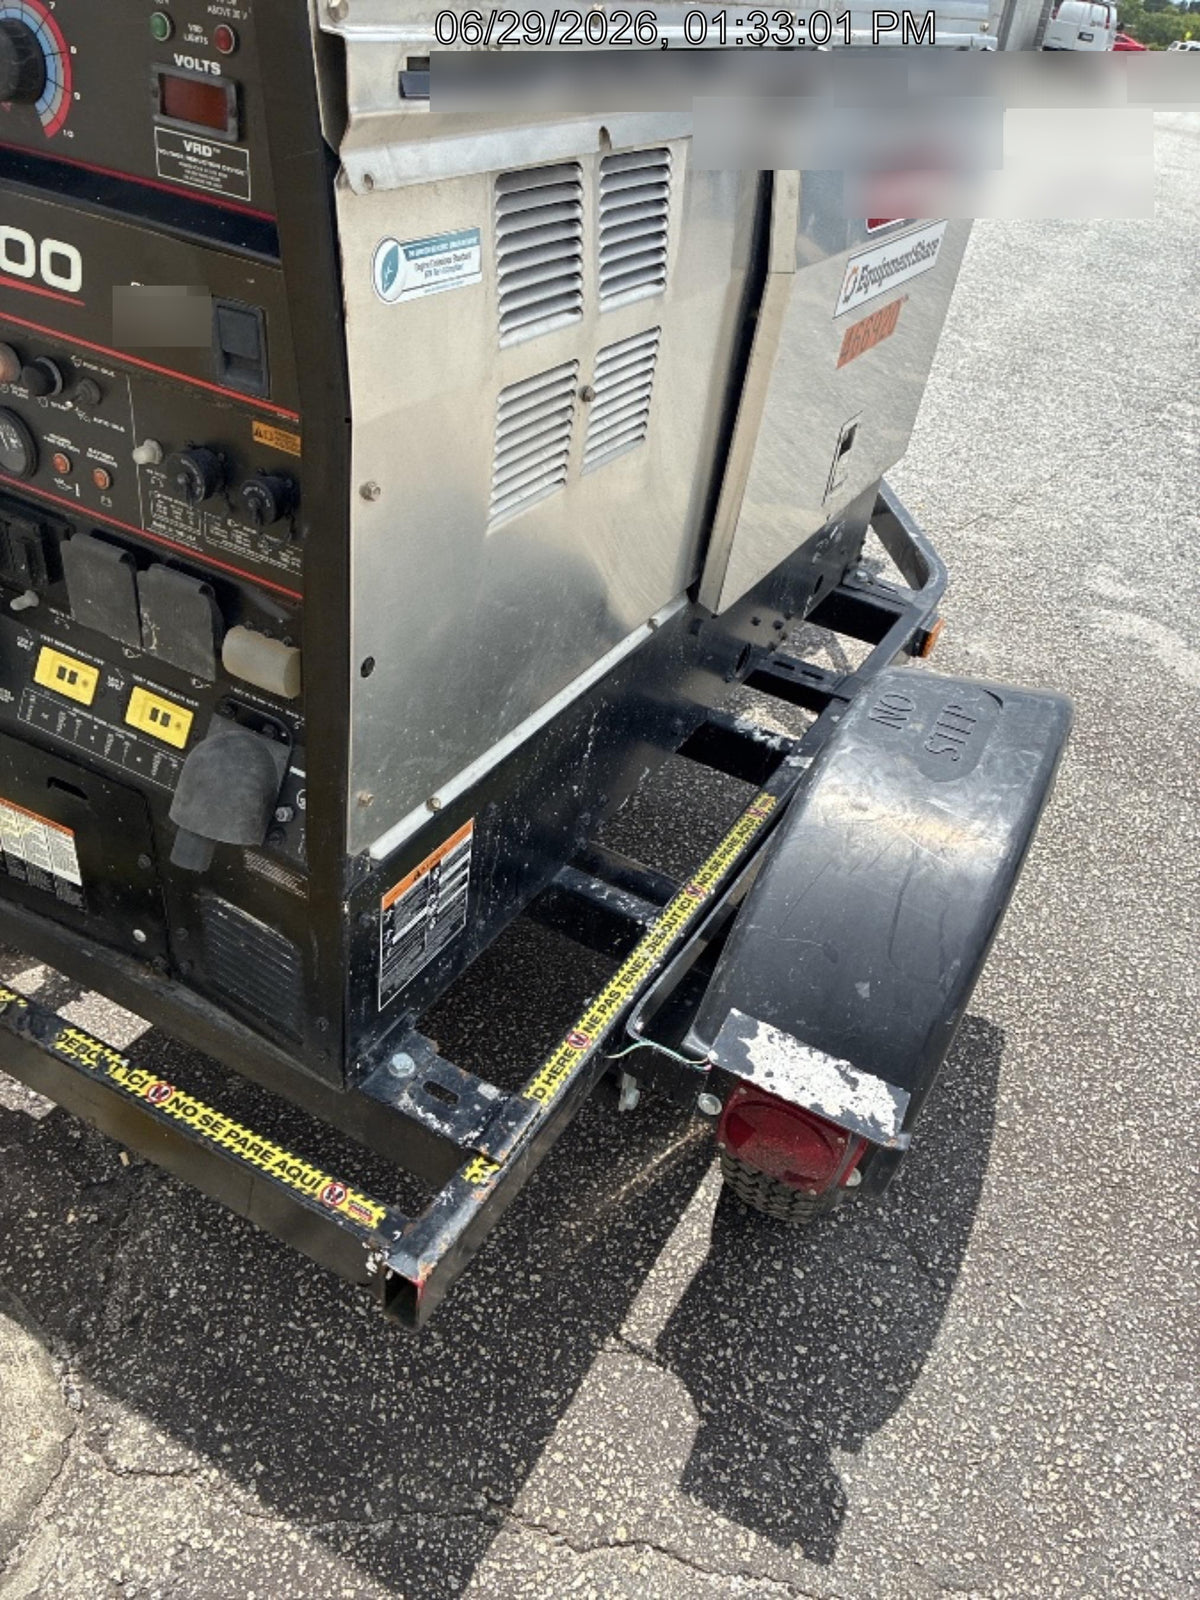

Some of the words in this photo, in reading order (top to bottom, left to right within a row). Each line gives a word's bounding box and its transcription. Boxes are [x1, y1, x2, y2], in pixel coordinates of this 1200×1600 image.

[49, 1, 56, 9] 7
[173, 53, 222, 75] VOLTS
[870, 694, 915, 730] NO
[924, 705, 977, 762] STEP
[542, 1048, 577, 1086] HERE
[583, 1015, 603, 1034] NE
[597, 990, 622, 1015] PAS
[645, 911, 681, 954] DEBOUT
[680, 897, 692, 912] ICI
[697, 872, 712, 886] NO
[709, 858, 724, 872] SE
[719, 837, 740, 859] PARE
[168, 1096, 198, 1117] NO
[198, 1114, 226, 1134] SE
[223, 1129, 276, 1163] PARE
[273, 1159, 323, 1190] AQUÍ
